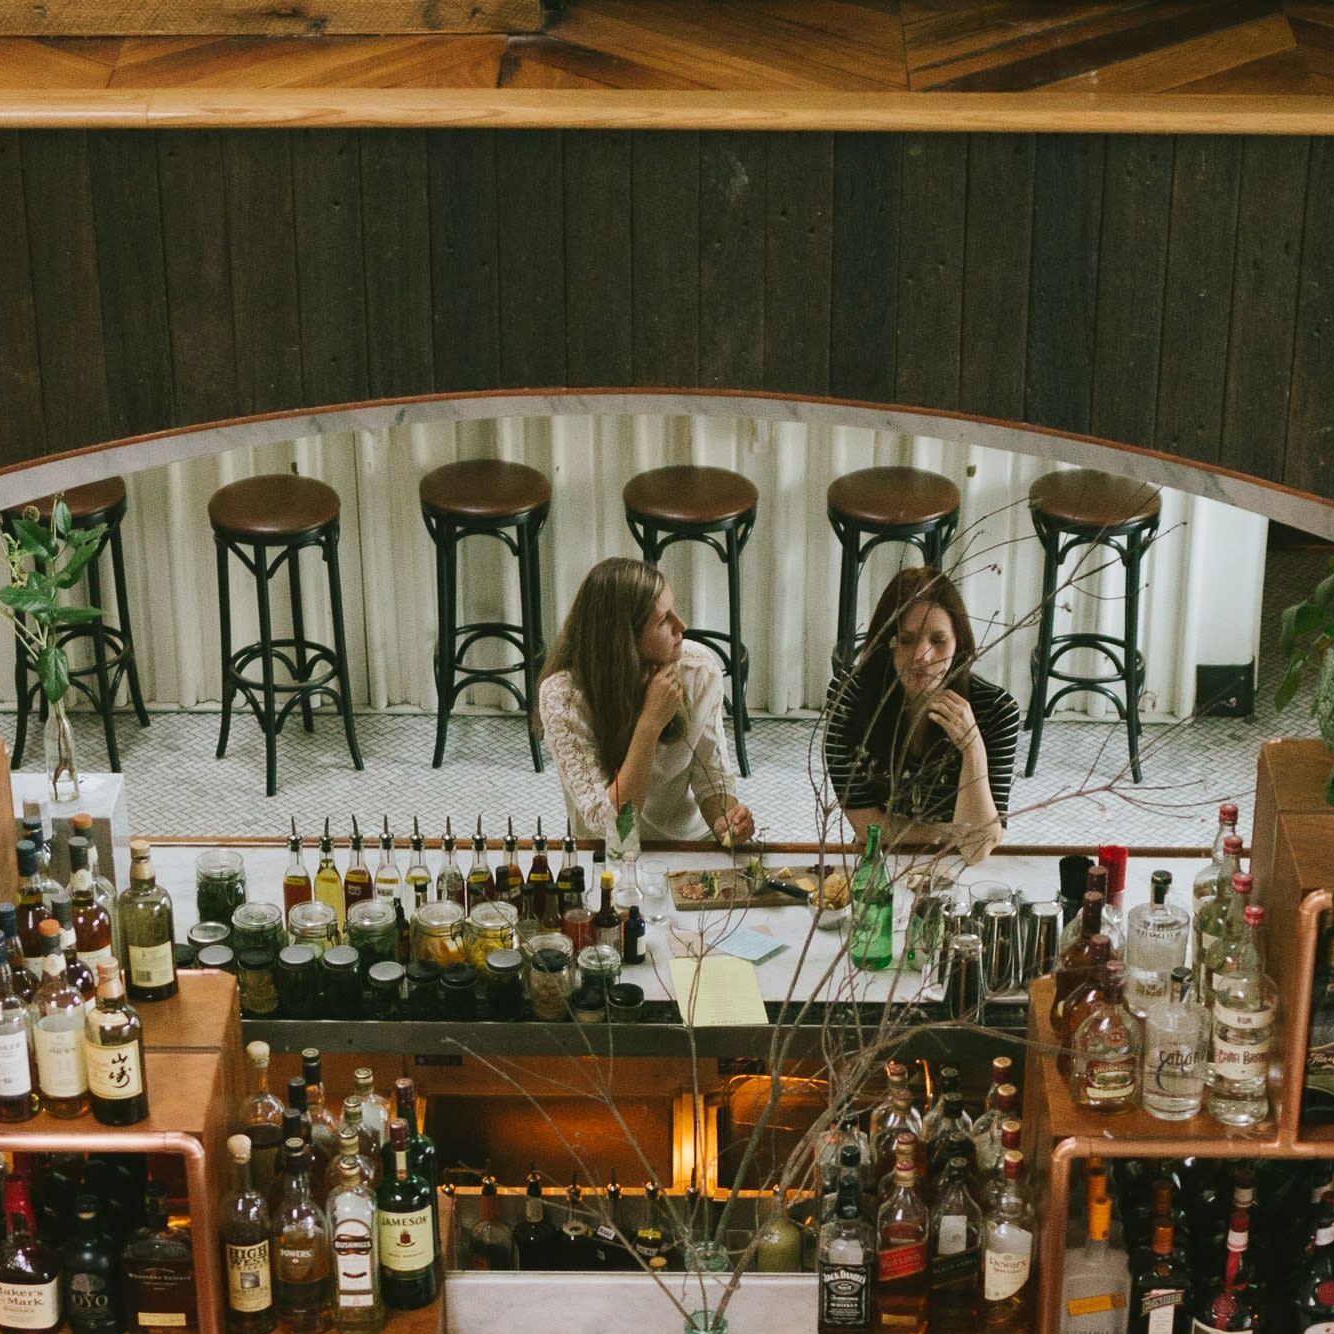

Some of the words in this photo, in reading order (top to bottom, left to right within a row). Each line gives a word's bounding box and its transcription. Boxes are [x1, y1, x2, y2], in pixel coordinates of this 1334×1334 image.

[381, 1215, 428, 1226] JAMESON
[229, 1247, 267, 1259] HIGH
[8, 1296, 44, 1306] Mark
